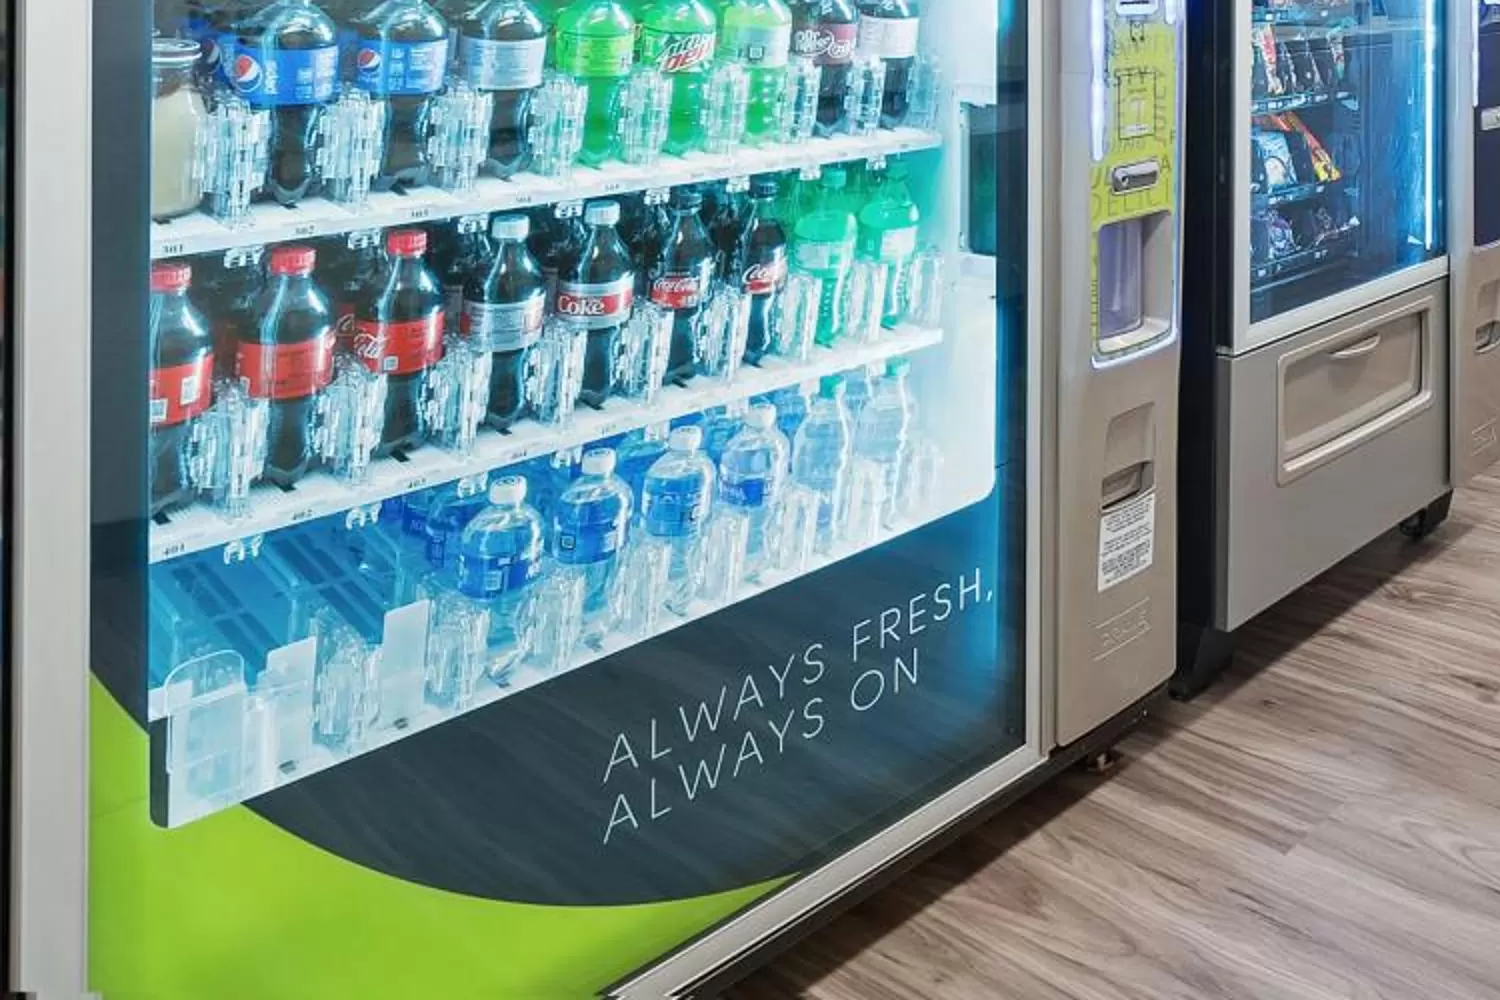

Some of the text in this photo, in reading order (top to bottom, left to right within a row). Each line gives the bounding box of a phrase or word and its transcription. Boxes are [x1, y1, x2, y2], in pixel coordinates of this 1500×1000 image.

[558, 295, 605, 315] Coke
[603, 567, 993, 784] ALWAYS FRESH,
[603, 647, 918, 845] ALWAYS ON
